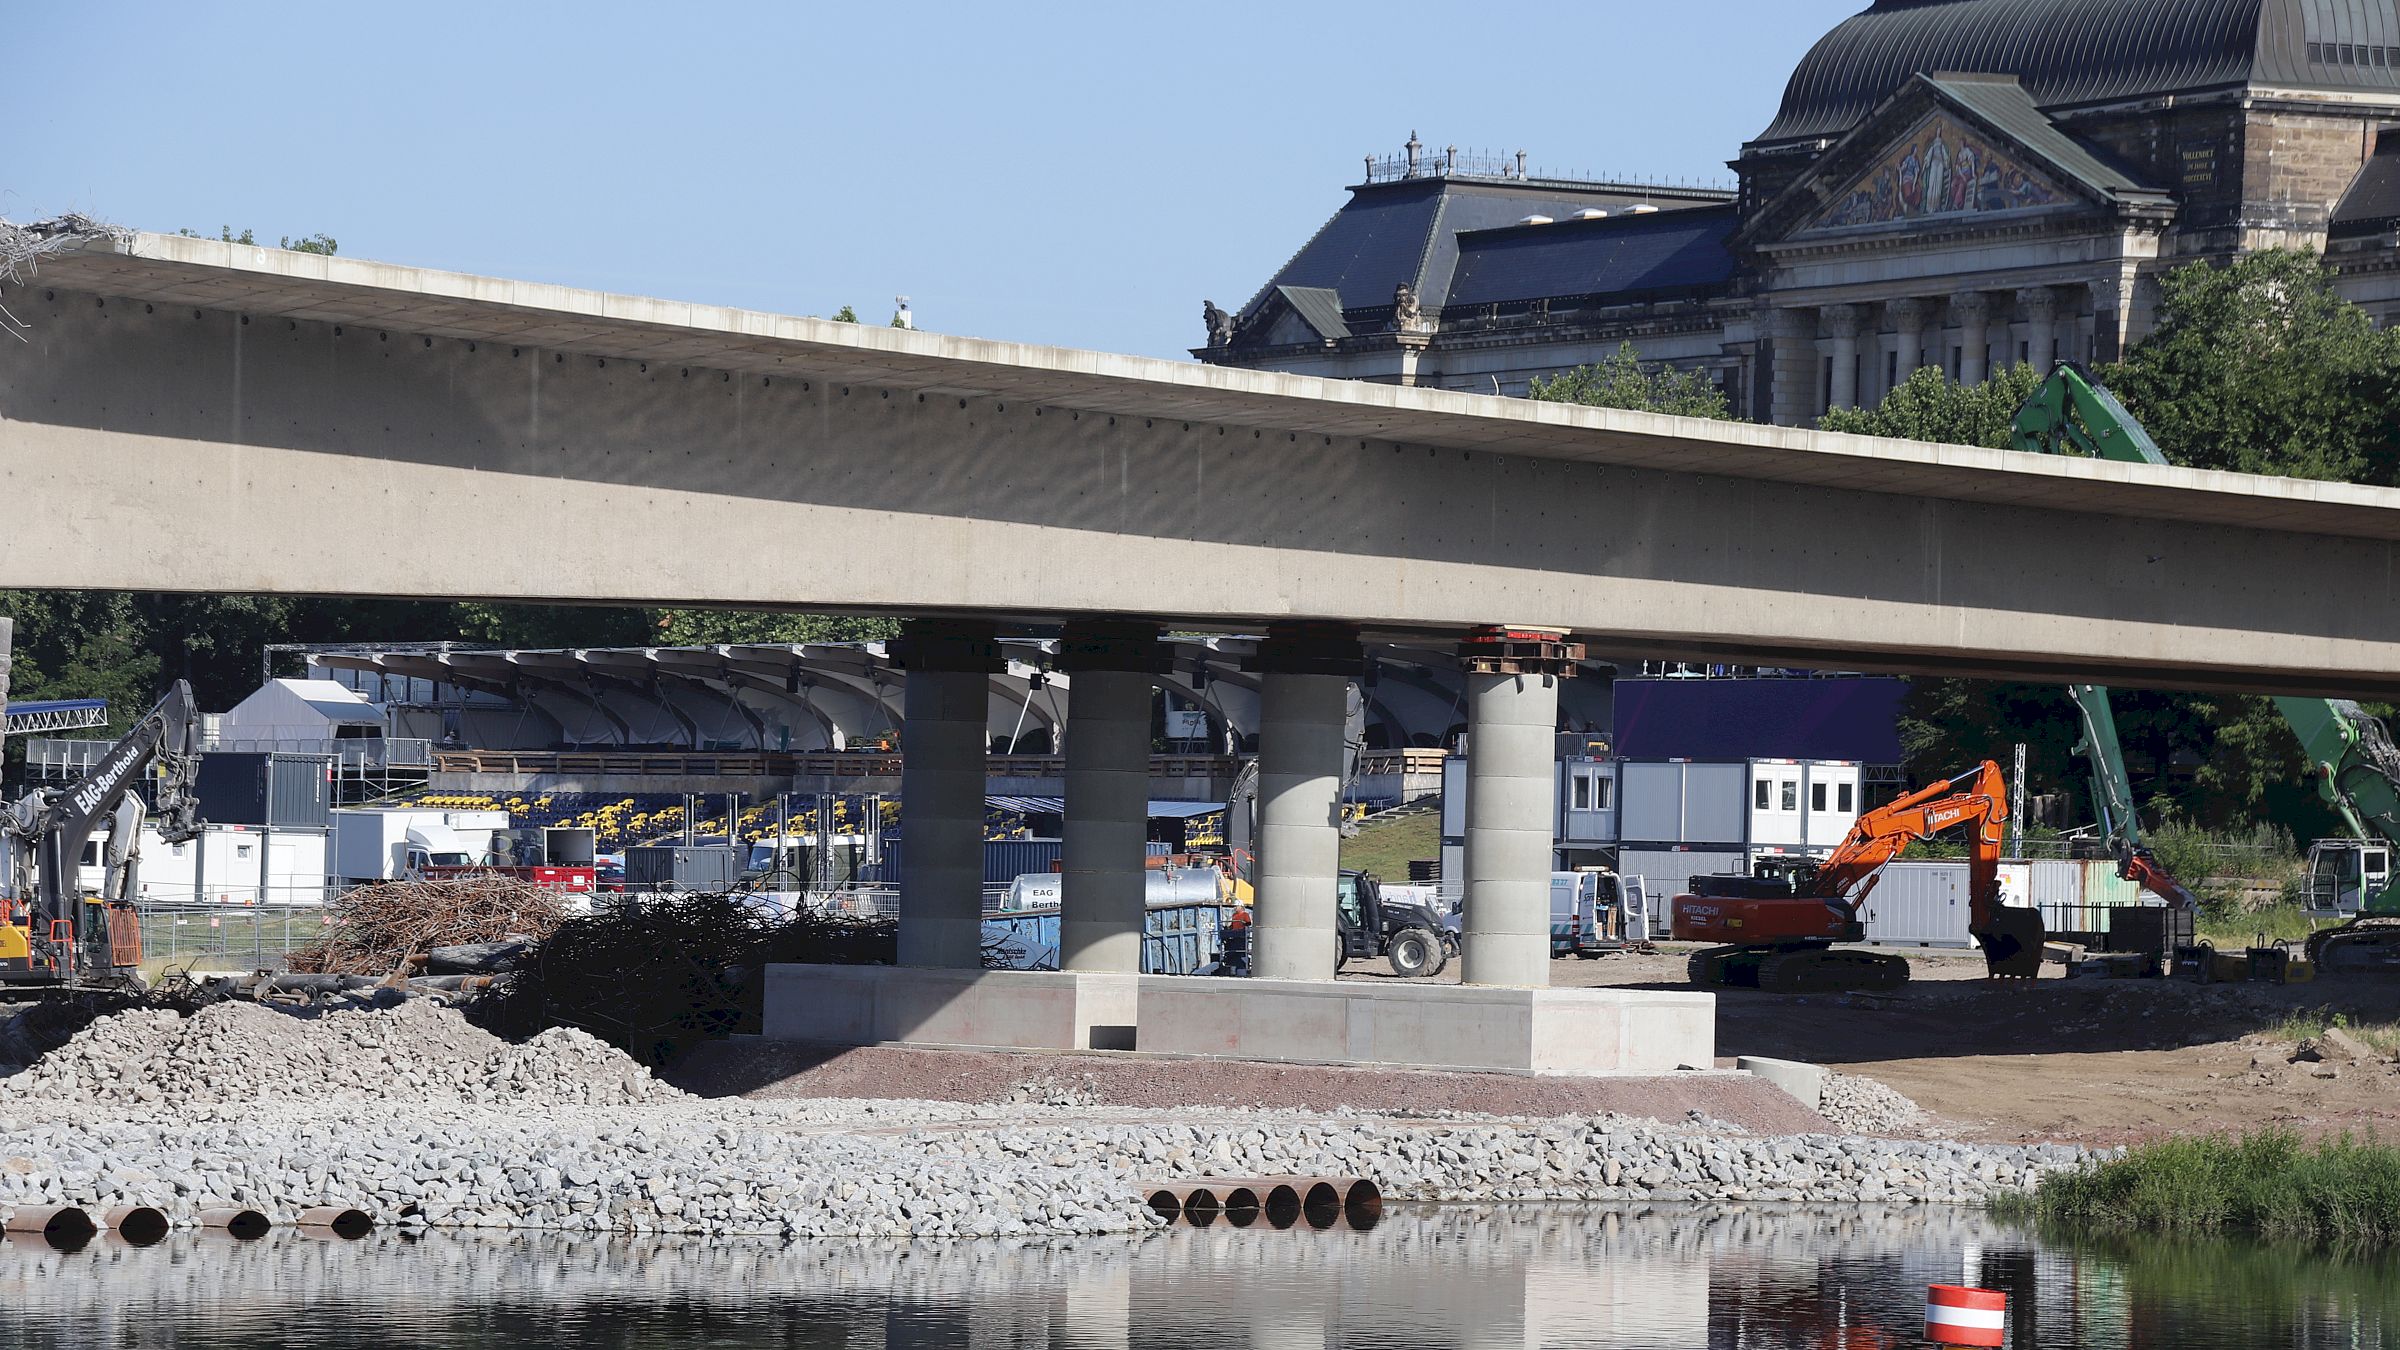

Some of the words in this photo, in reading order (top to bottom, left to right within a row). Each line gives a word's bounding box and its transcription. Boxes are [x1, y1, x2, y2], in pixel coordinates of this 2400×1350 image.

[74, 746, 139, 816] EAG-Berthold
[1033, 889, 1053, 897] EAG
[1682, 904, 1719, 915] HITACHI
